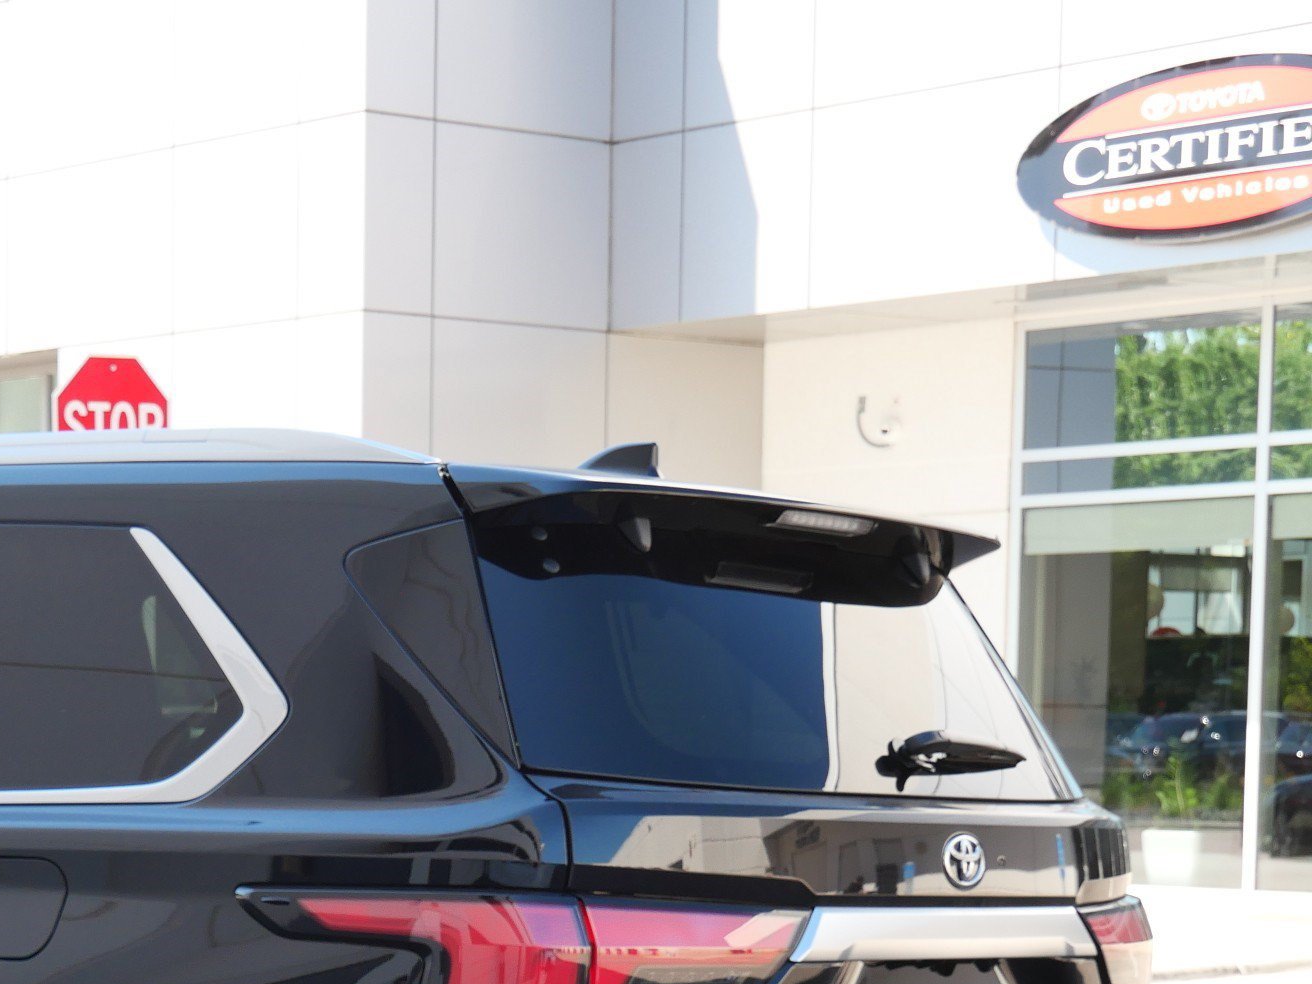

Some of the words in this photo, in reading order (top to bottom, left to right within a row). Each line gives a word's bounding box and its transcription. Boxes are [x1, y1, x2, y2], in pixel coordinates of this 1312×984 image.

[1175, 80, 1265, 114] TOYOTA
[1103, 190, 1172, 214] Used
[1181, 175, 1309, 203] Vehicles
[63, 400, 165, 431] STOP
